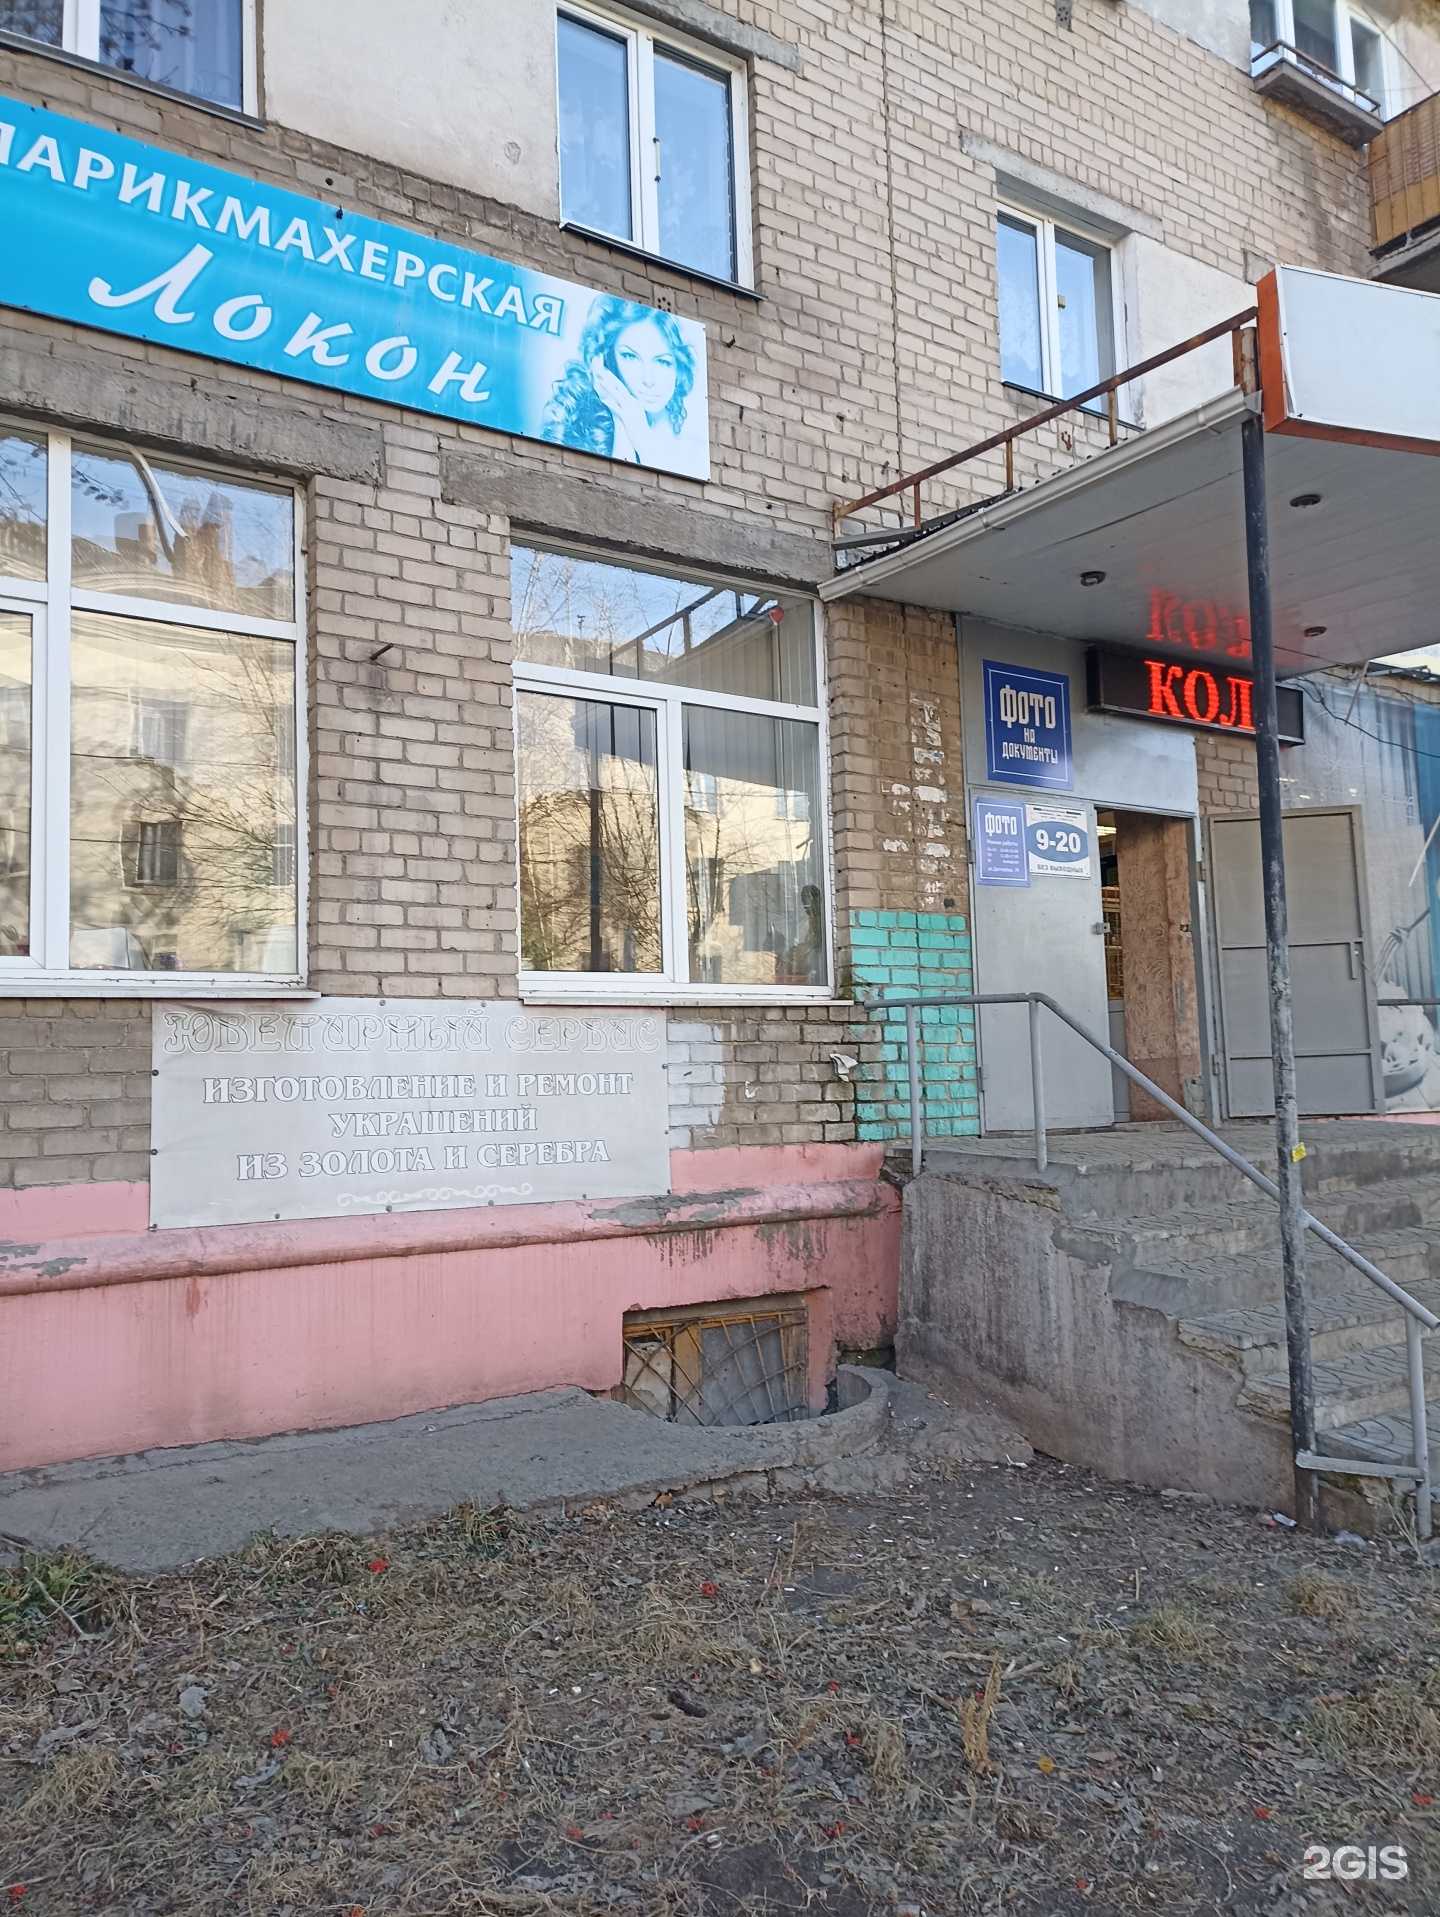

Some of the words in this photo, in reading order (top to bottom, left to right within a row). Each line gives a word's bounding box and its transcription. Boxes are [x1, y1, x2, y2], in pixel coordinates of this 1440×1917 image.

[87, 242, 493, 403] Локон
[999, 684, 1056, 729] ФОТО
[1144, 660, 1256, 730] КОЛ
[984, 812, 1018, 837] ФОТО
[1036, 829, 1081, 854] 9-20
[164, 1008, 492, 1053] ЮВЕЛИРНЫЙ
[504, 1015, 660, 1053] СЕРВИС
[203, 1074, 475, 1103] ИЗГОТОВЛЕНИЕ
[485, 1073, 509, 1098] И
[517, 1072, 634, 1097] РЕМОНТ
[328, 1104, 537, 1138] УКРАШЕНИЙ
[236, 1152, 288, 1180] ИЗ
[299, 1147, 435, 1177] ЗОЛОТА
[444, 1145, 468, 1169] И
[477, 1139, 611, 1167] СЕРЕБРА
